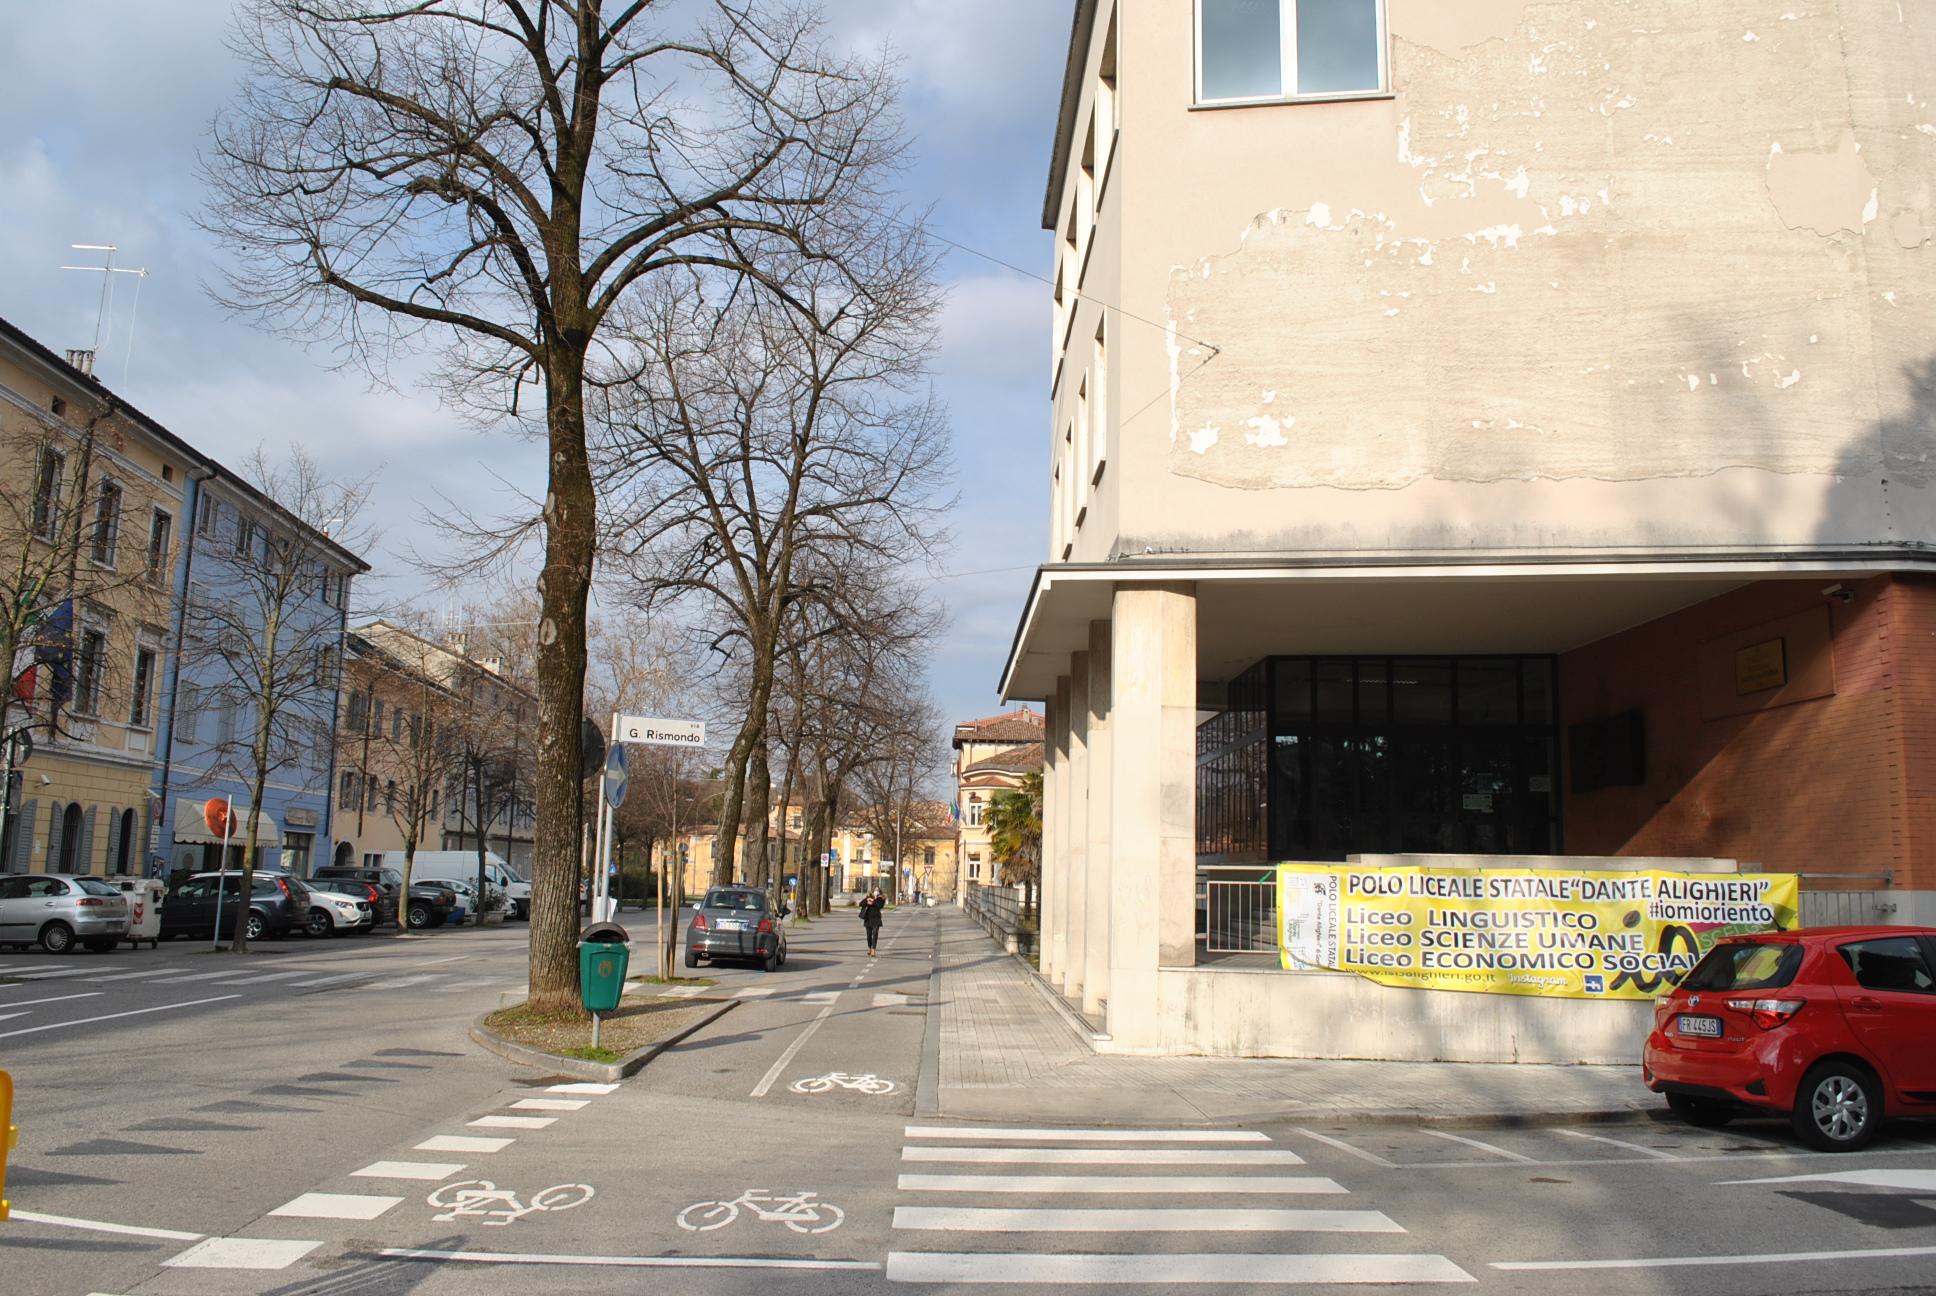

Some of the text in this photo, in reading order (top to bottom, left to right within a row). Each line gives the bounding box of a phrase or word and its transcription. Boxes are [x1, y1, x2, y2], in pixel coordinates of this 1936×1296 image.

[629, 728, 700, 743] G. Rismondo
[1328, 875, 1337, 901] POLO
[1349, 875, 1403, 895] POLO
[1409, 875, 1483, 898] LICEALE
[1328, 903, 1336, 939] LICEALE
[1346, 907, 1597, 930] Liceo LINGUISTICO
[1650, 900, 1772, 922] #iomioriento
[1346, 928, 1644, 951] Liceo SCIENZE UMANE
[1345, 948, 1412, 967] Liceo
[1421, 951, 1594, 970] ECONOMICO
[1682, 1018, 1692, 1031] FR
